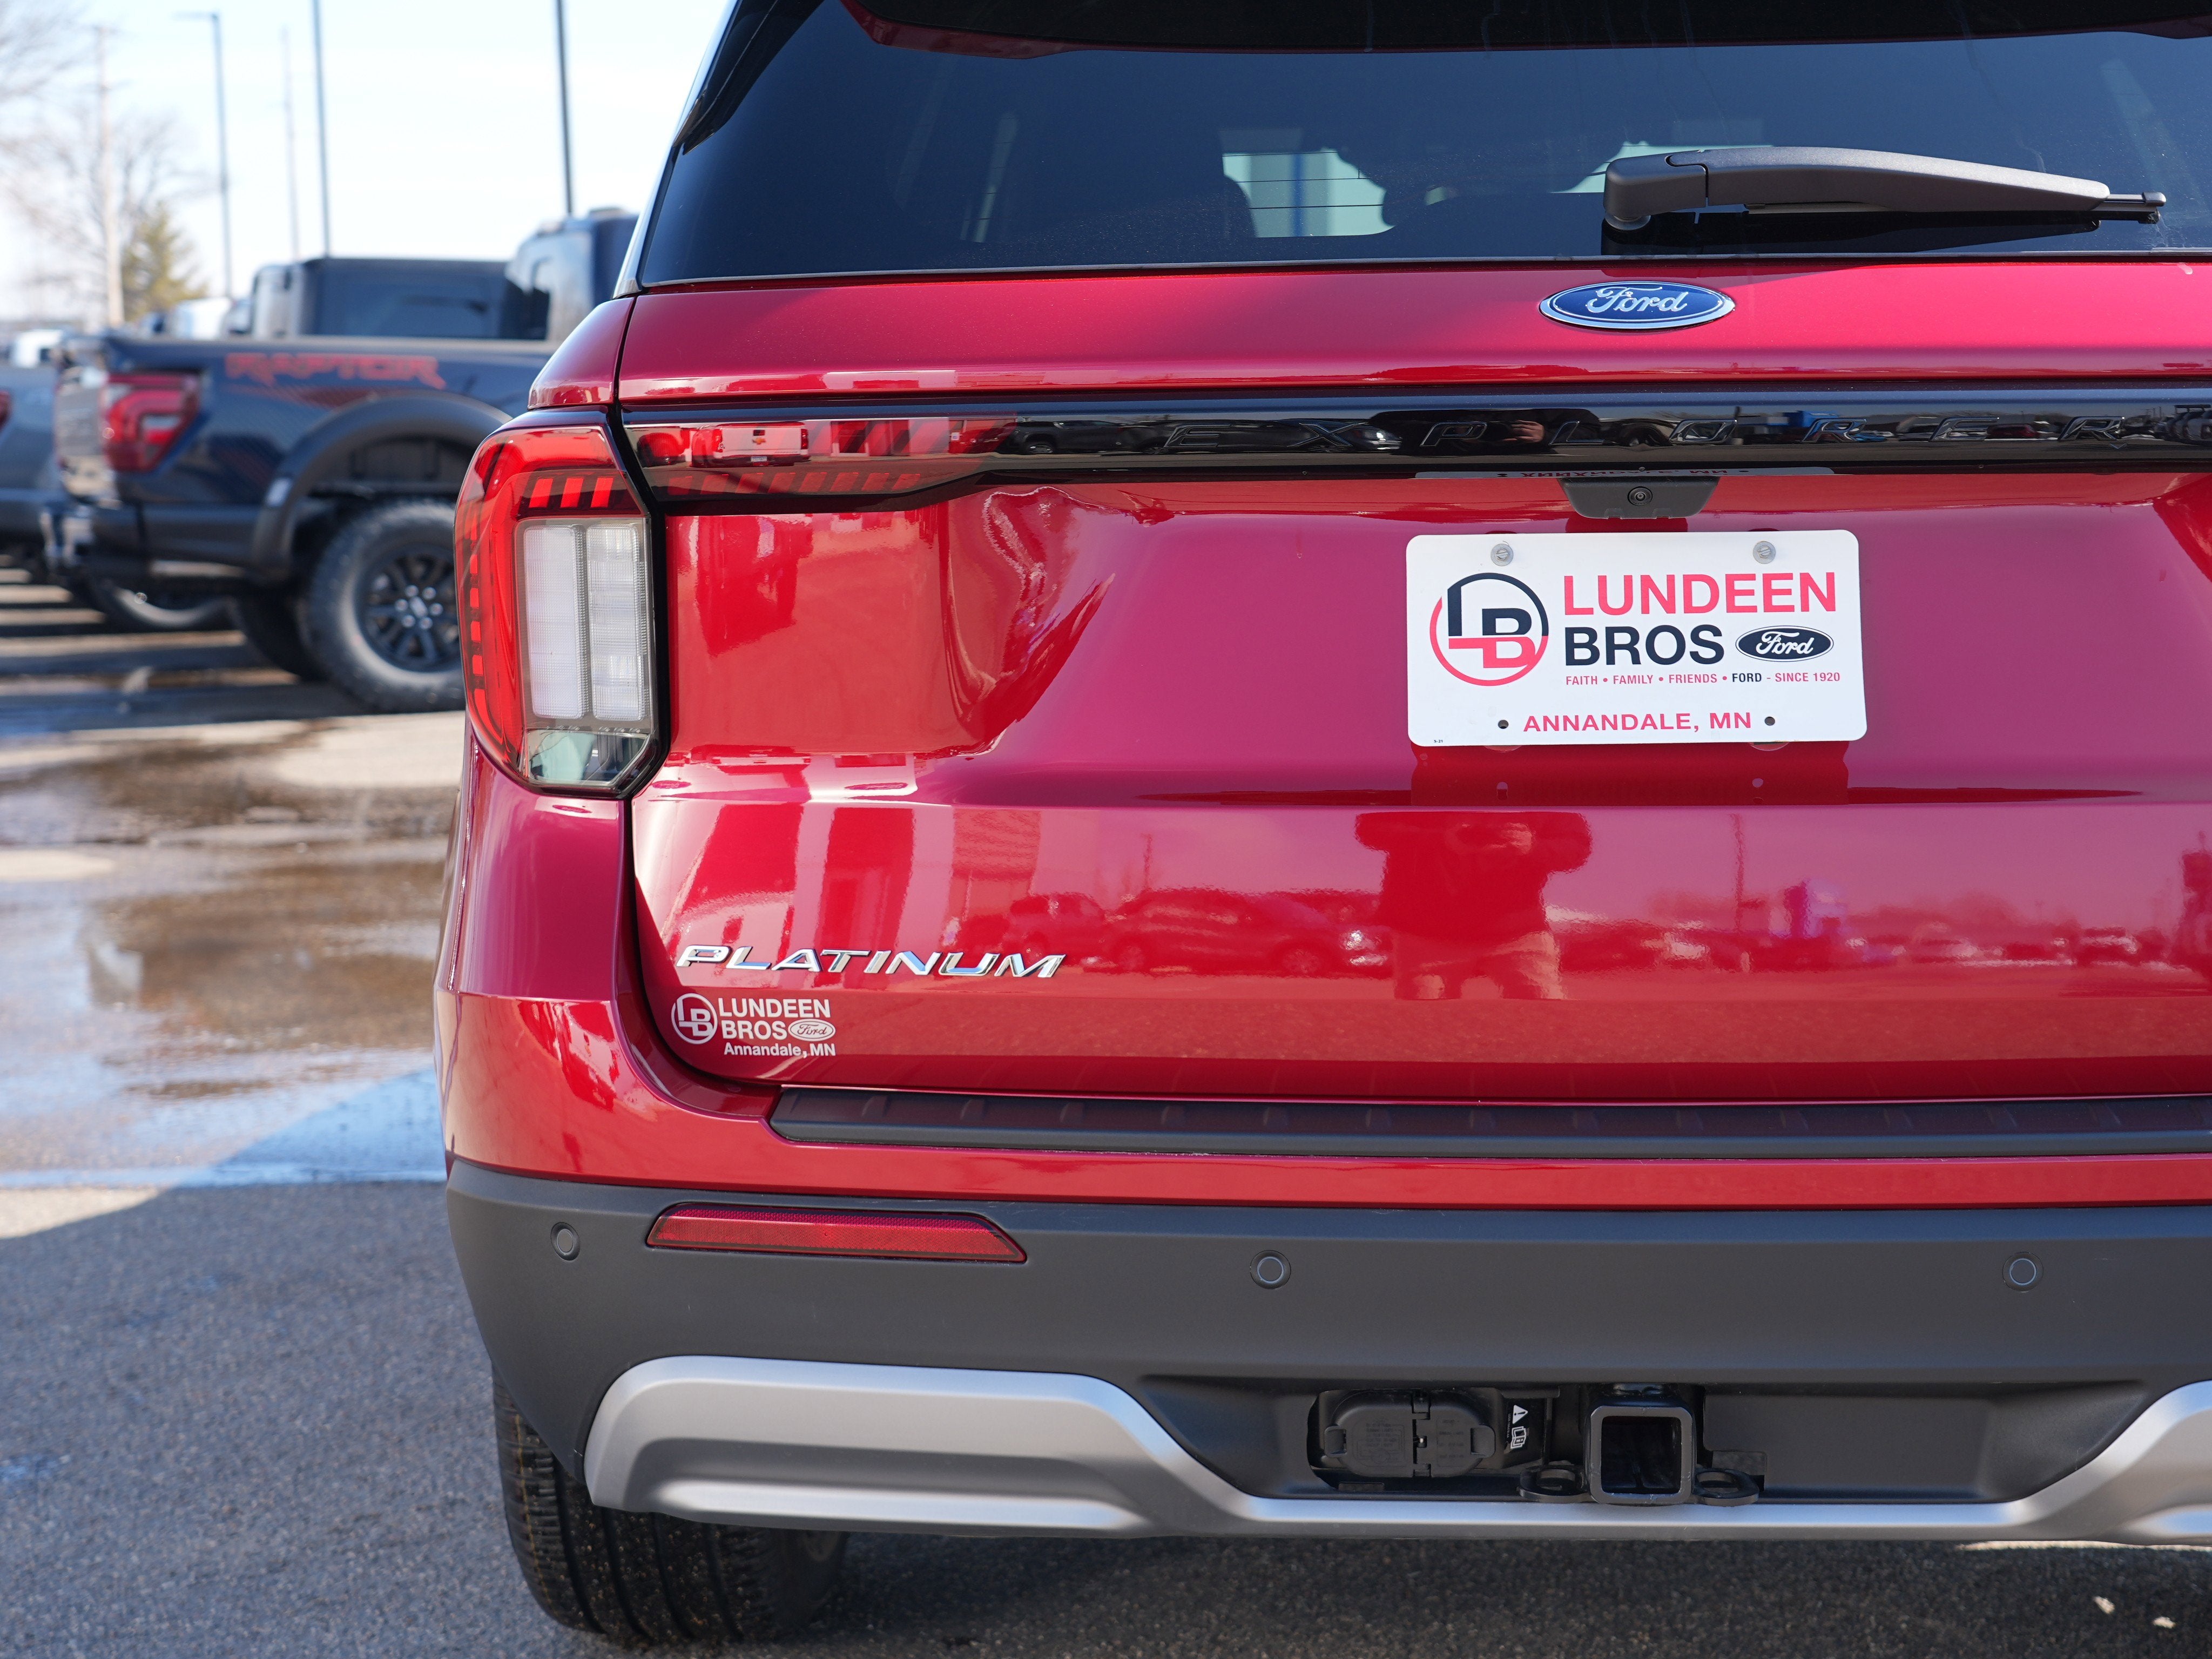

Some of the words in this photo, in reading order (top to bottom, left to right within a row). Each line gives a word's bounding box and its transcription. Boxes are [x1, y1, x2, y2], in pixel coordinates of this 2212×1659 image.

[1586, 286, 1689, 313] Ford
[224, 352, 447, 390] RAPTOR
[1163, 416, 2127, 448] EXPLORER
[1563, 571, 1837, 615] LUNDEEN
[1565, 624, 1725, 666] BROS
[1756, 631, 1815, 655] Ford
[1566, 675, 1599, 685] FAITH
[1613, 674, 1654, 685] FAMILY
[1668, 673, 1718, 684] FRIENDS
[1732, 672, 1762, 683] FORD
[1775, 672, 1809, 682] SINCE
[1813, 671, 1841, 682] 1920
[1523, 712, 1700, 732] ANNANDALE,
[1709, 712, 1751, 729] MN
[675, 945, 1067, 979] PLATINUM
[718, 997, 832, 1018] LUNDEEN
[721, 1020, 788, 1040] BROS
[797, 1023, 828, 1035] Ford
[723, 1042, 808, 1058] Annandale,
[810, 1043, 837, 1057] MN
